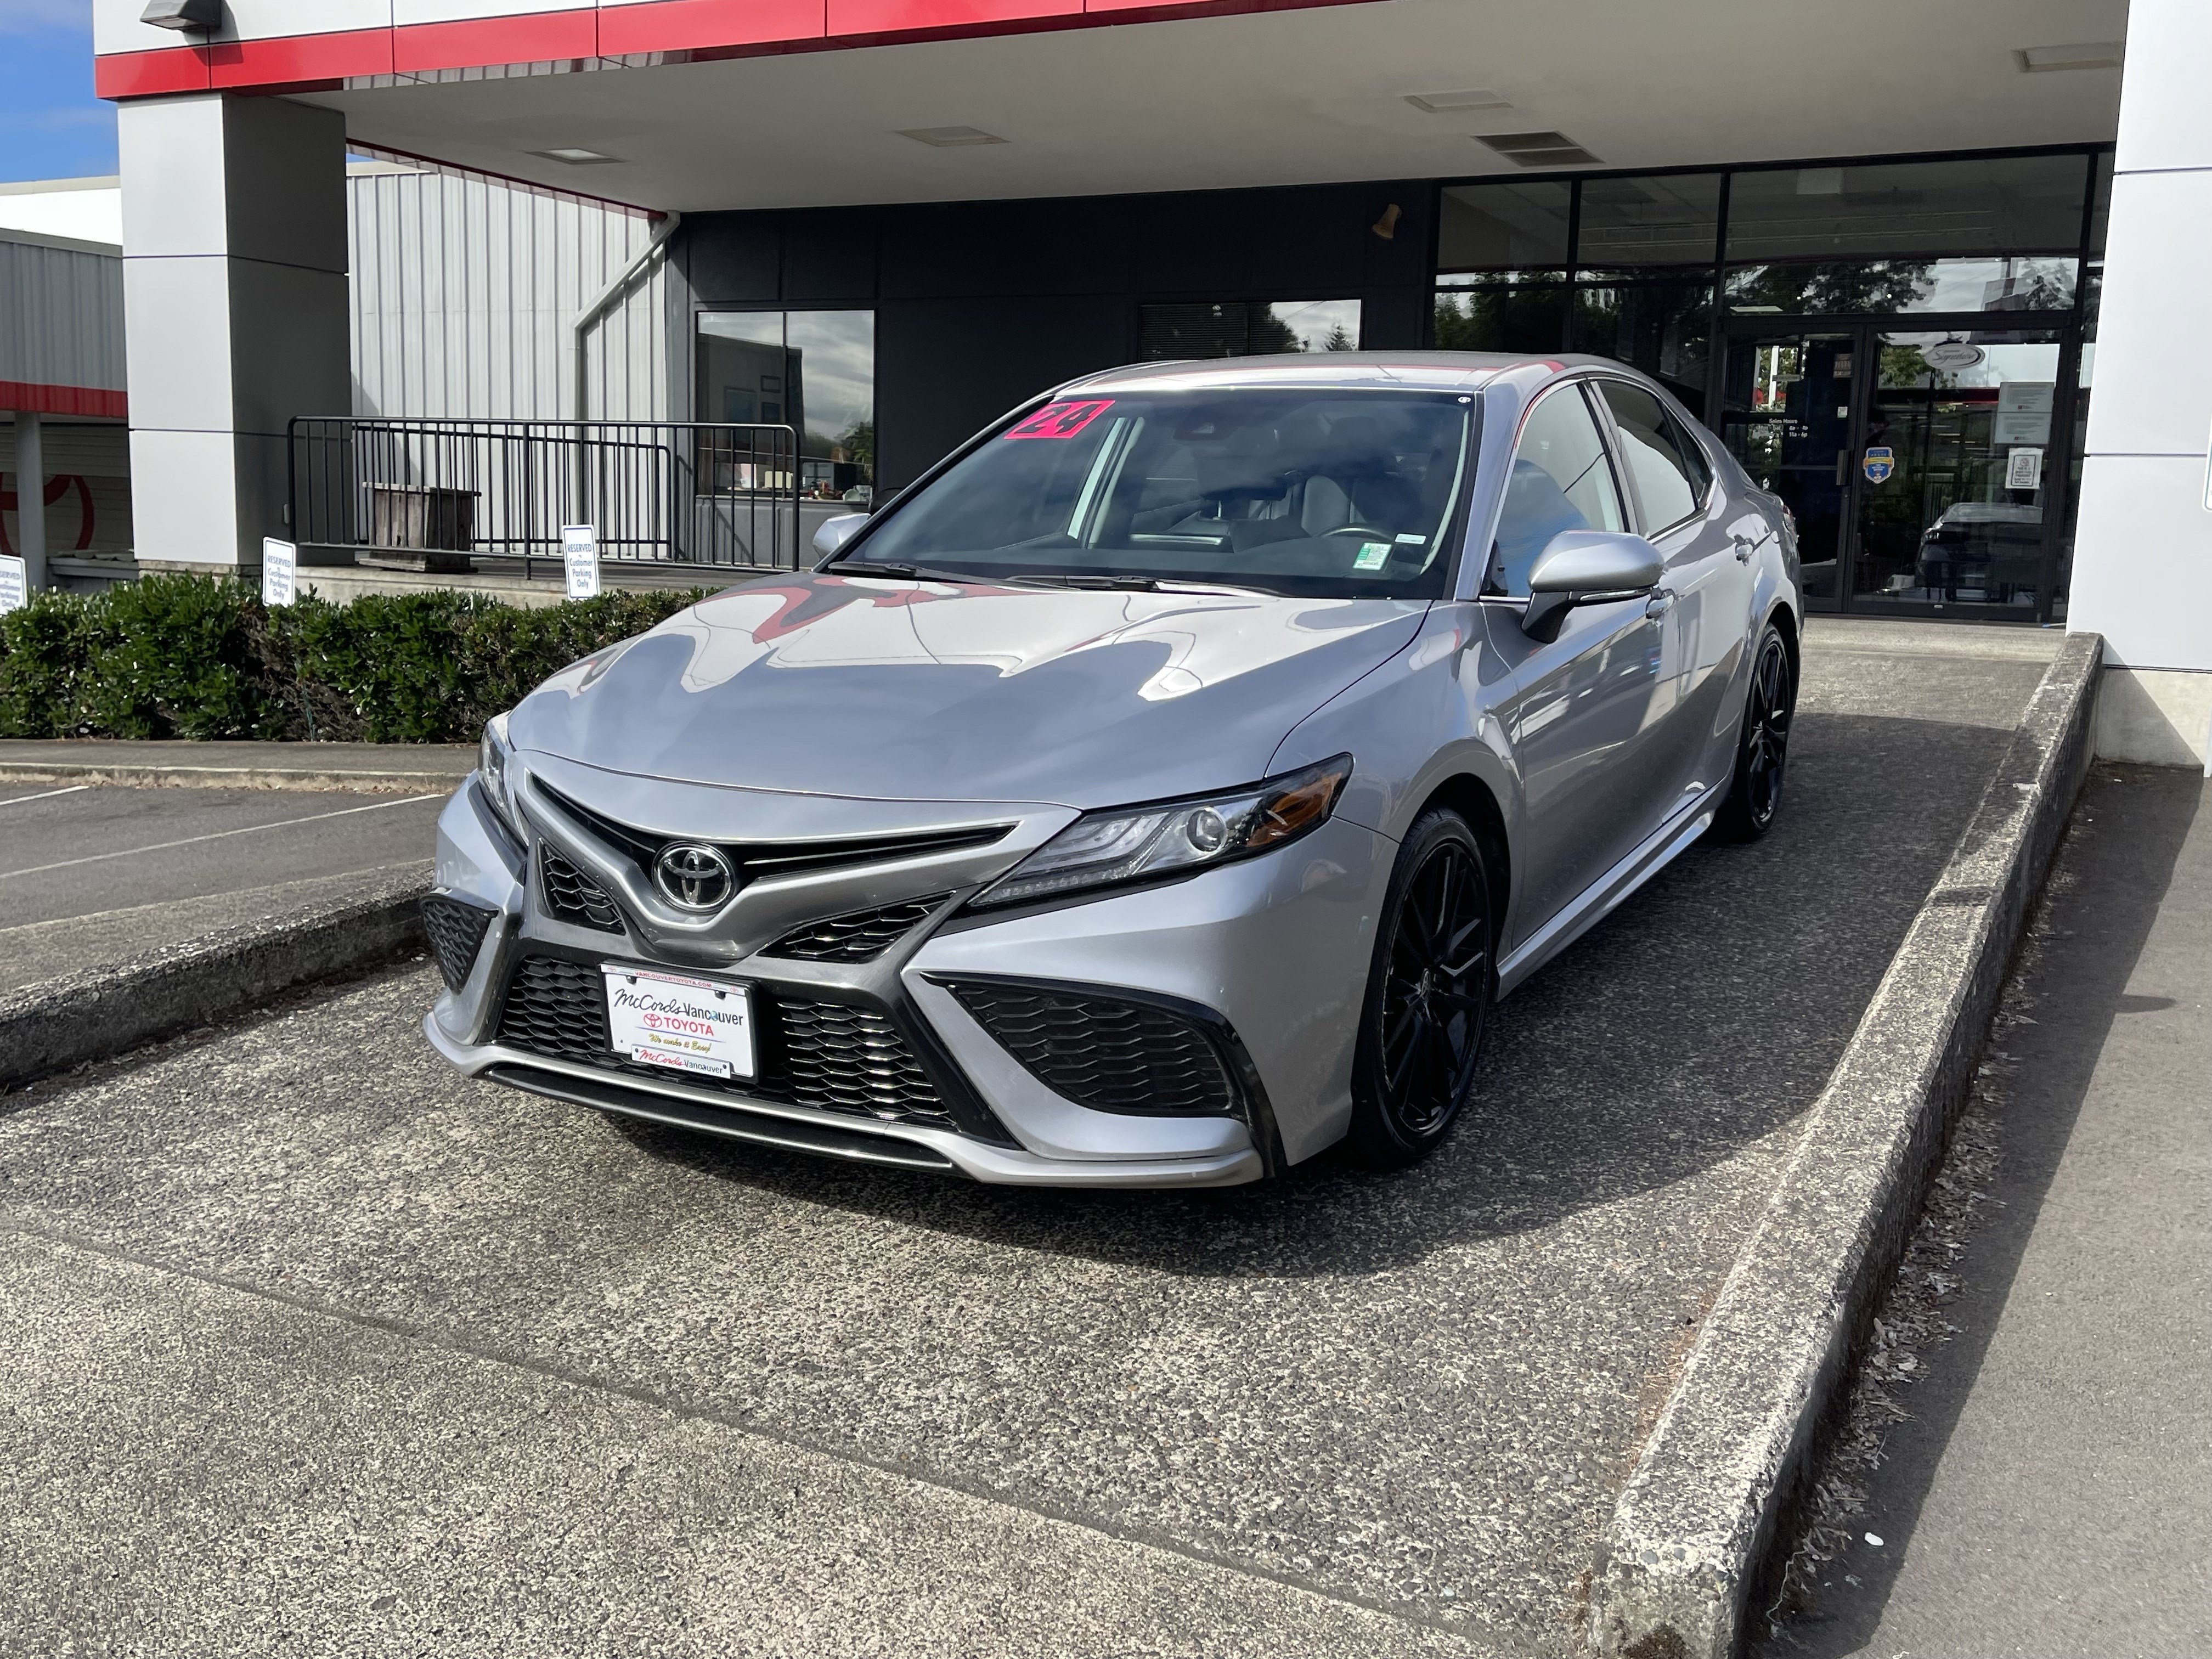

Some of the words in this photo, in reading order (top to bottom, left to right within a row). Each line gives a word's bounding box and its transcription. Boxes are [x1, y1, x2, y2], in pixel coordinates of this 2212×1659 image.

[1014, 404, 1102, 435] 24
[567, 544, 592, 552] RESERVED
[267, 555, 291, 568] RESERVED
[569, 558, 593, 567] Customer
[268, 567, 291, 580] Customer
[572, 568, 592, 579] Parking
[269, 578, 288, 592] Parking
[577, 579, 589, 589] Only
[273, 589, 285, 600] Only
[635, 971, 712, 988] VANCOUVERTOYOTA.COM
[664, 1017, 714, 1036] TOYOTA
